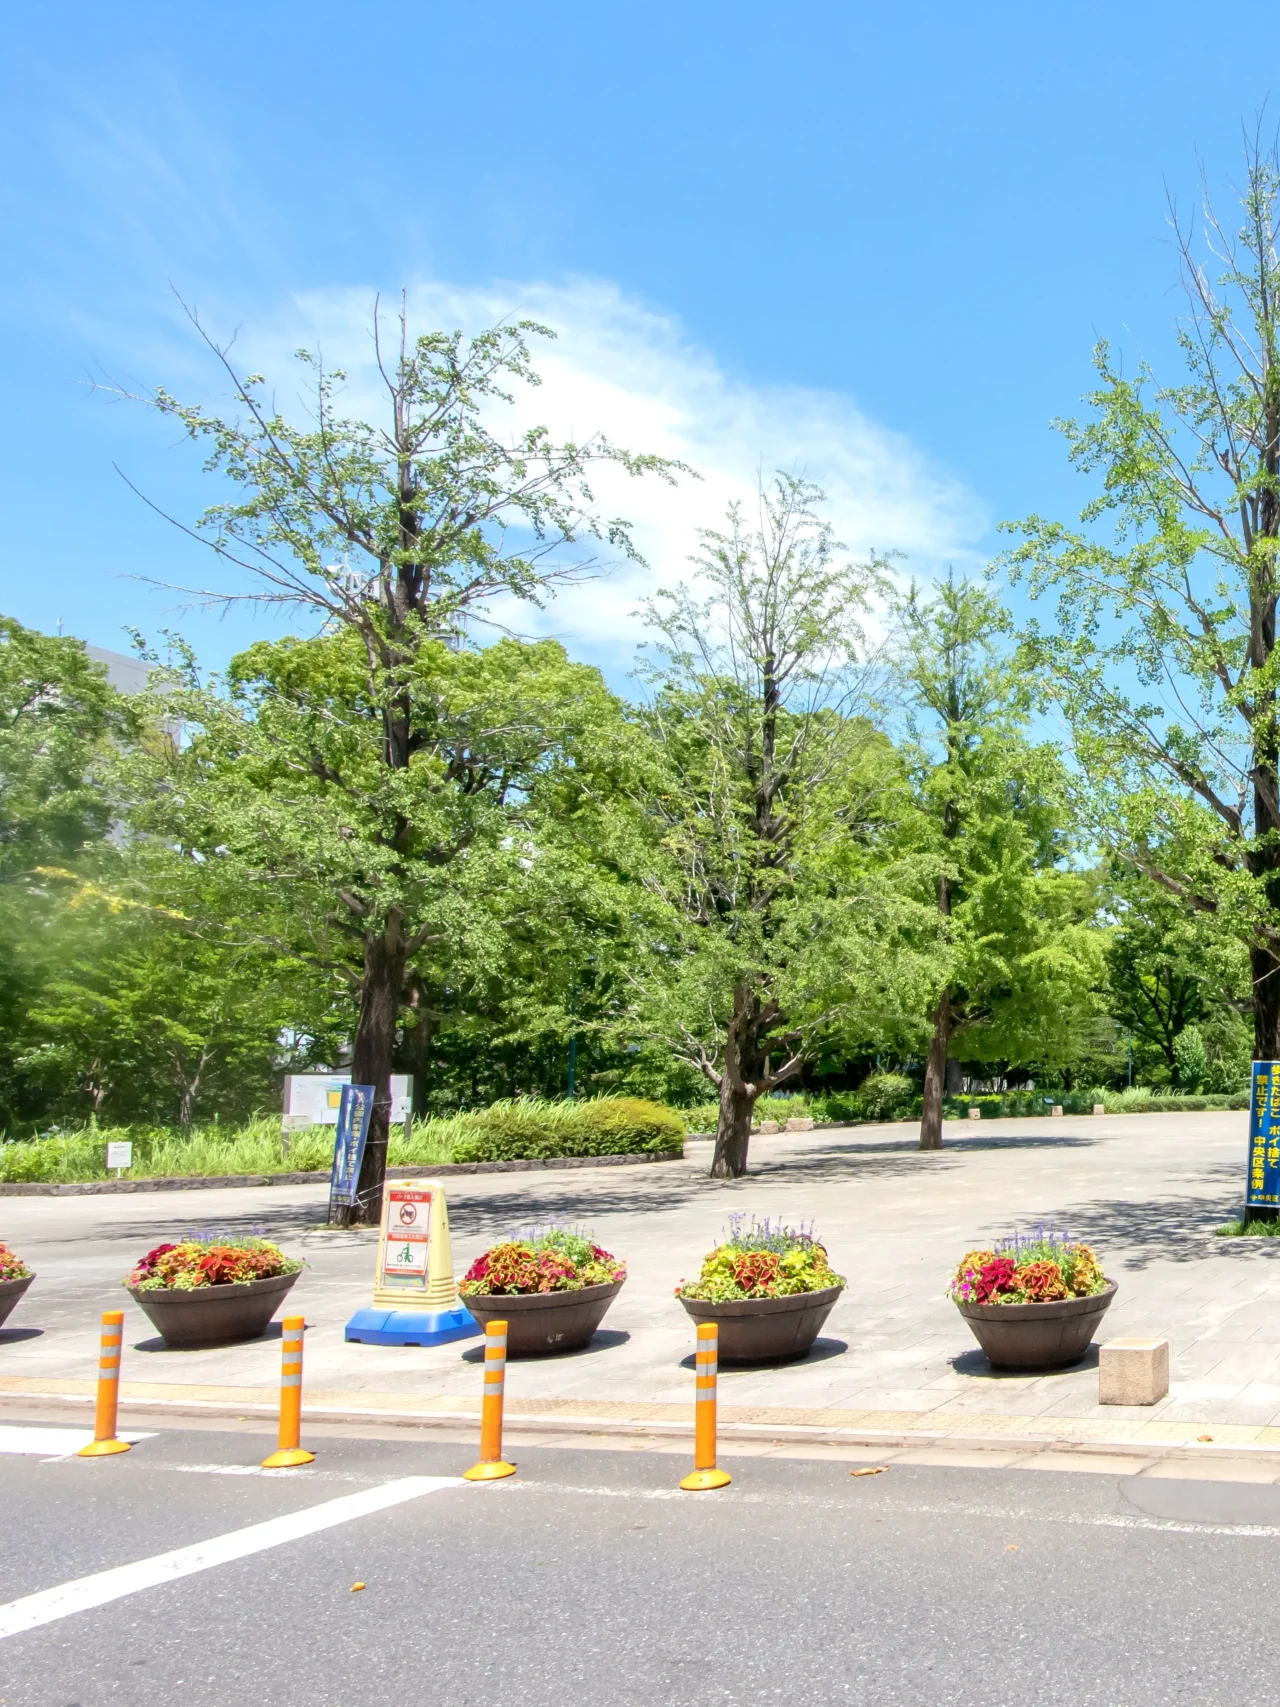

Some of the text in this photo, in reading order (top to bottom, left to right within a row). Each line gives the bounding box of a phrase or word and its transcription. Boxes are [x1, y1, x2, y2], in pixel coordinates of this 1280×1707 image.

[1251, 1135, 1266, 1191] 中央区条例
